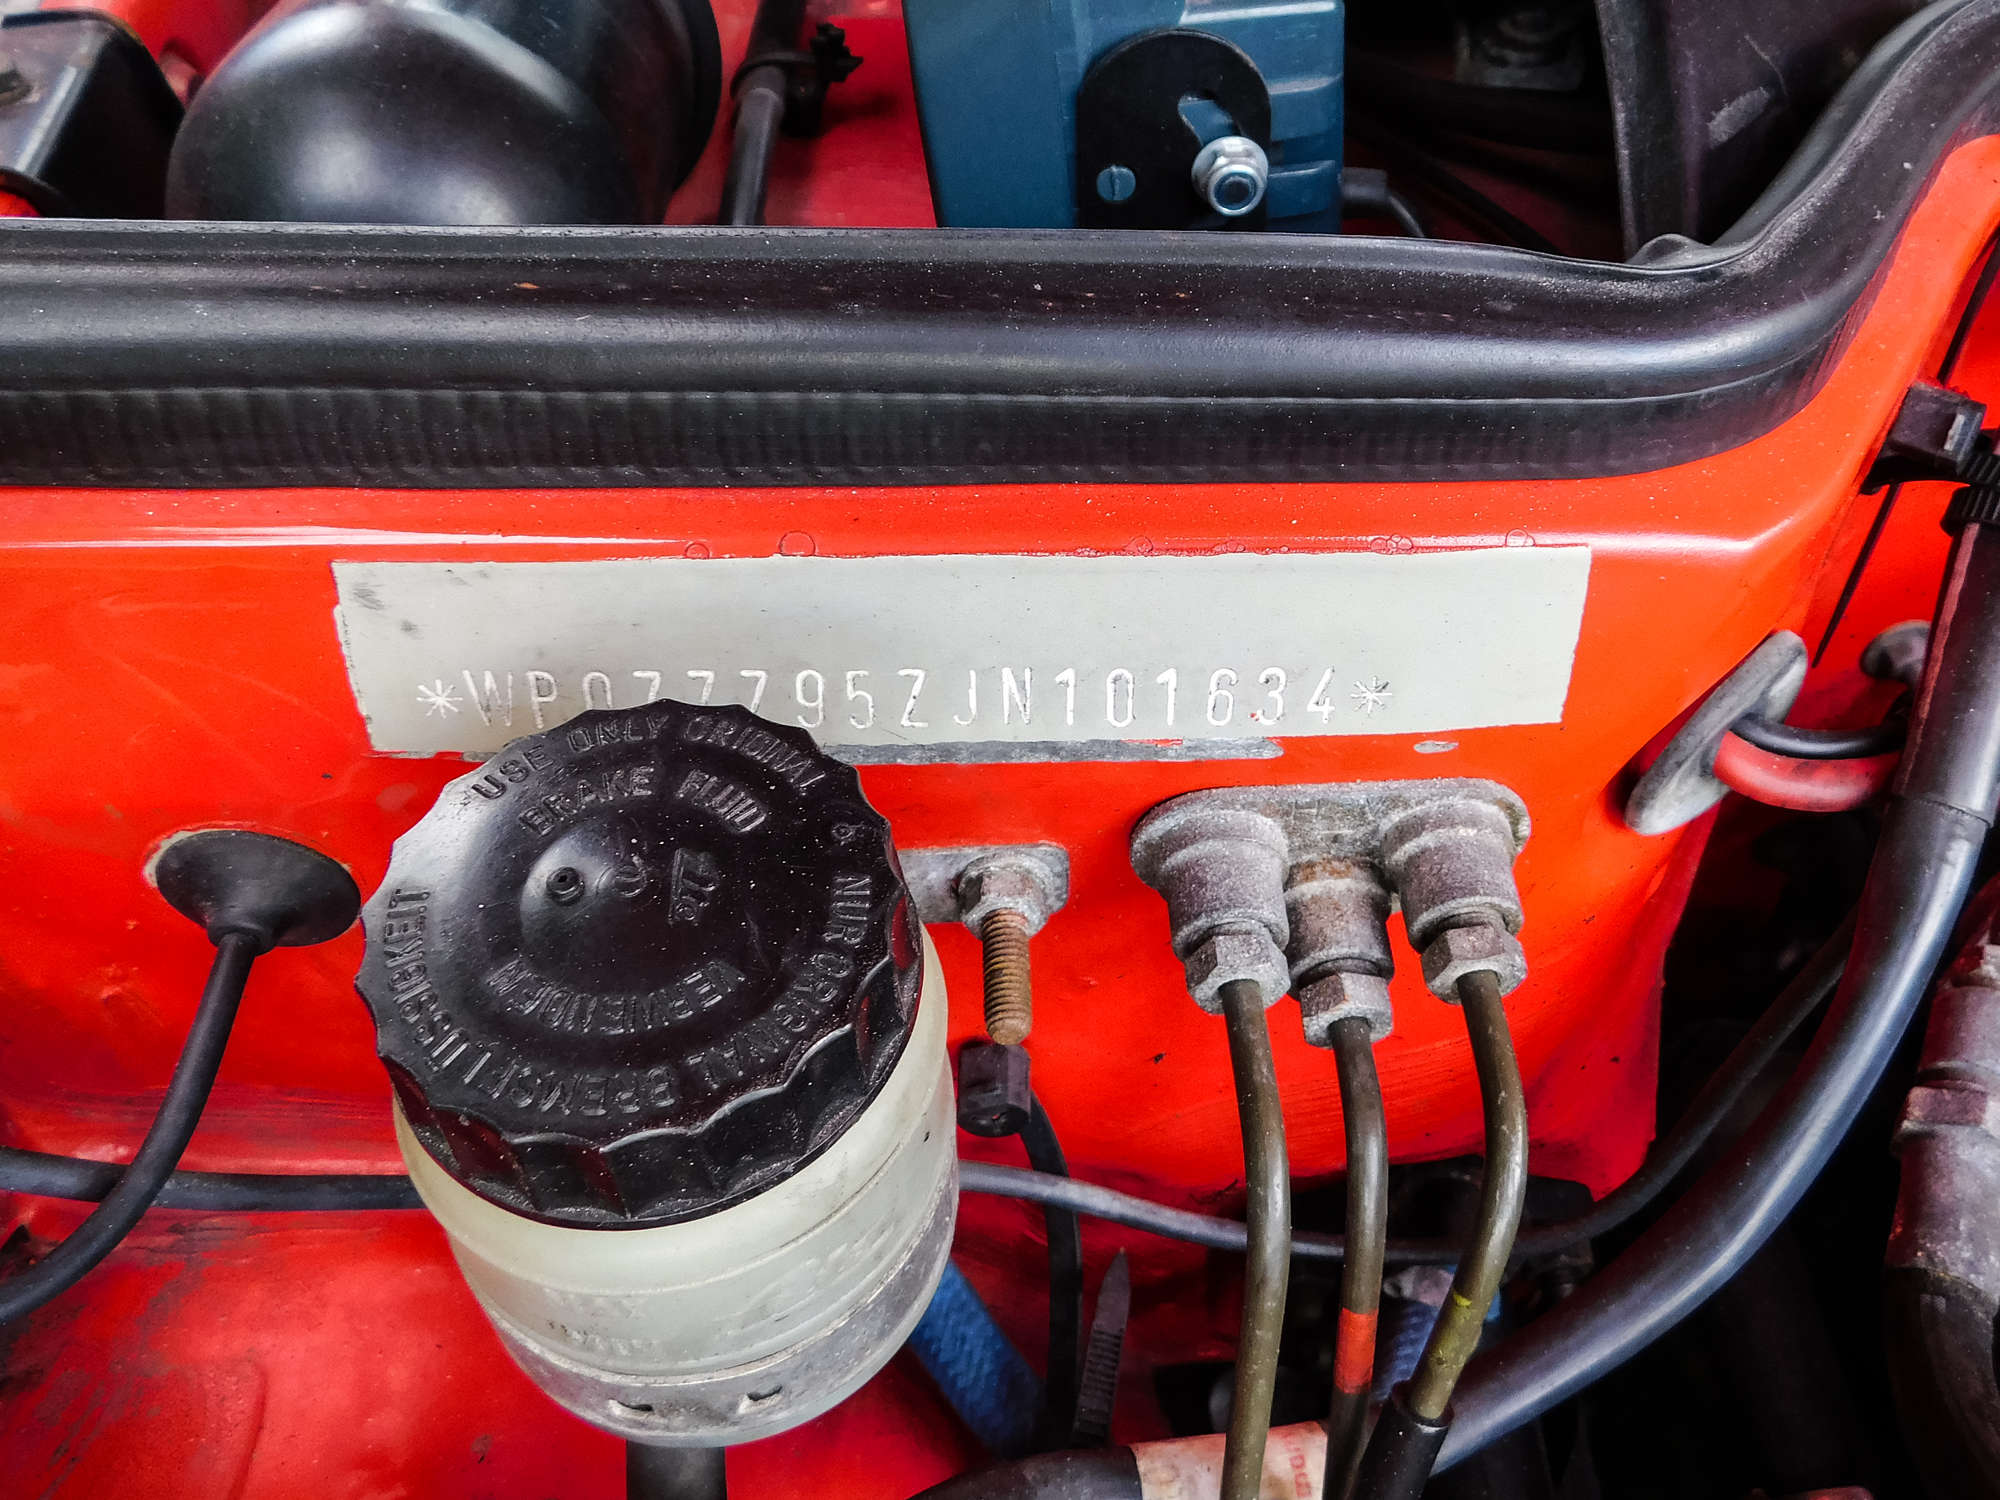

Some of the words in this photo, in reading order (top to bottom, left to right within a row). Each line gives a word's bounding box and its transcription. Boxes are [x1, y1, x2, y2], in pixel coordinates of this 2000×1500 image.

[472, 745, 554, 800] USE
[567, 714, 671, 754] ONLY
[518, 761, 654, 836] BRAKE
[674, 769, 767, 833] FLUID
[822, 875, 872, 944] NUR
